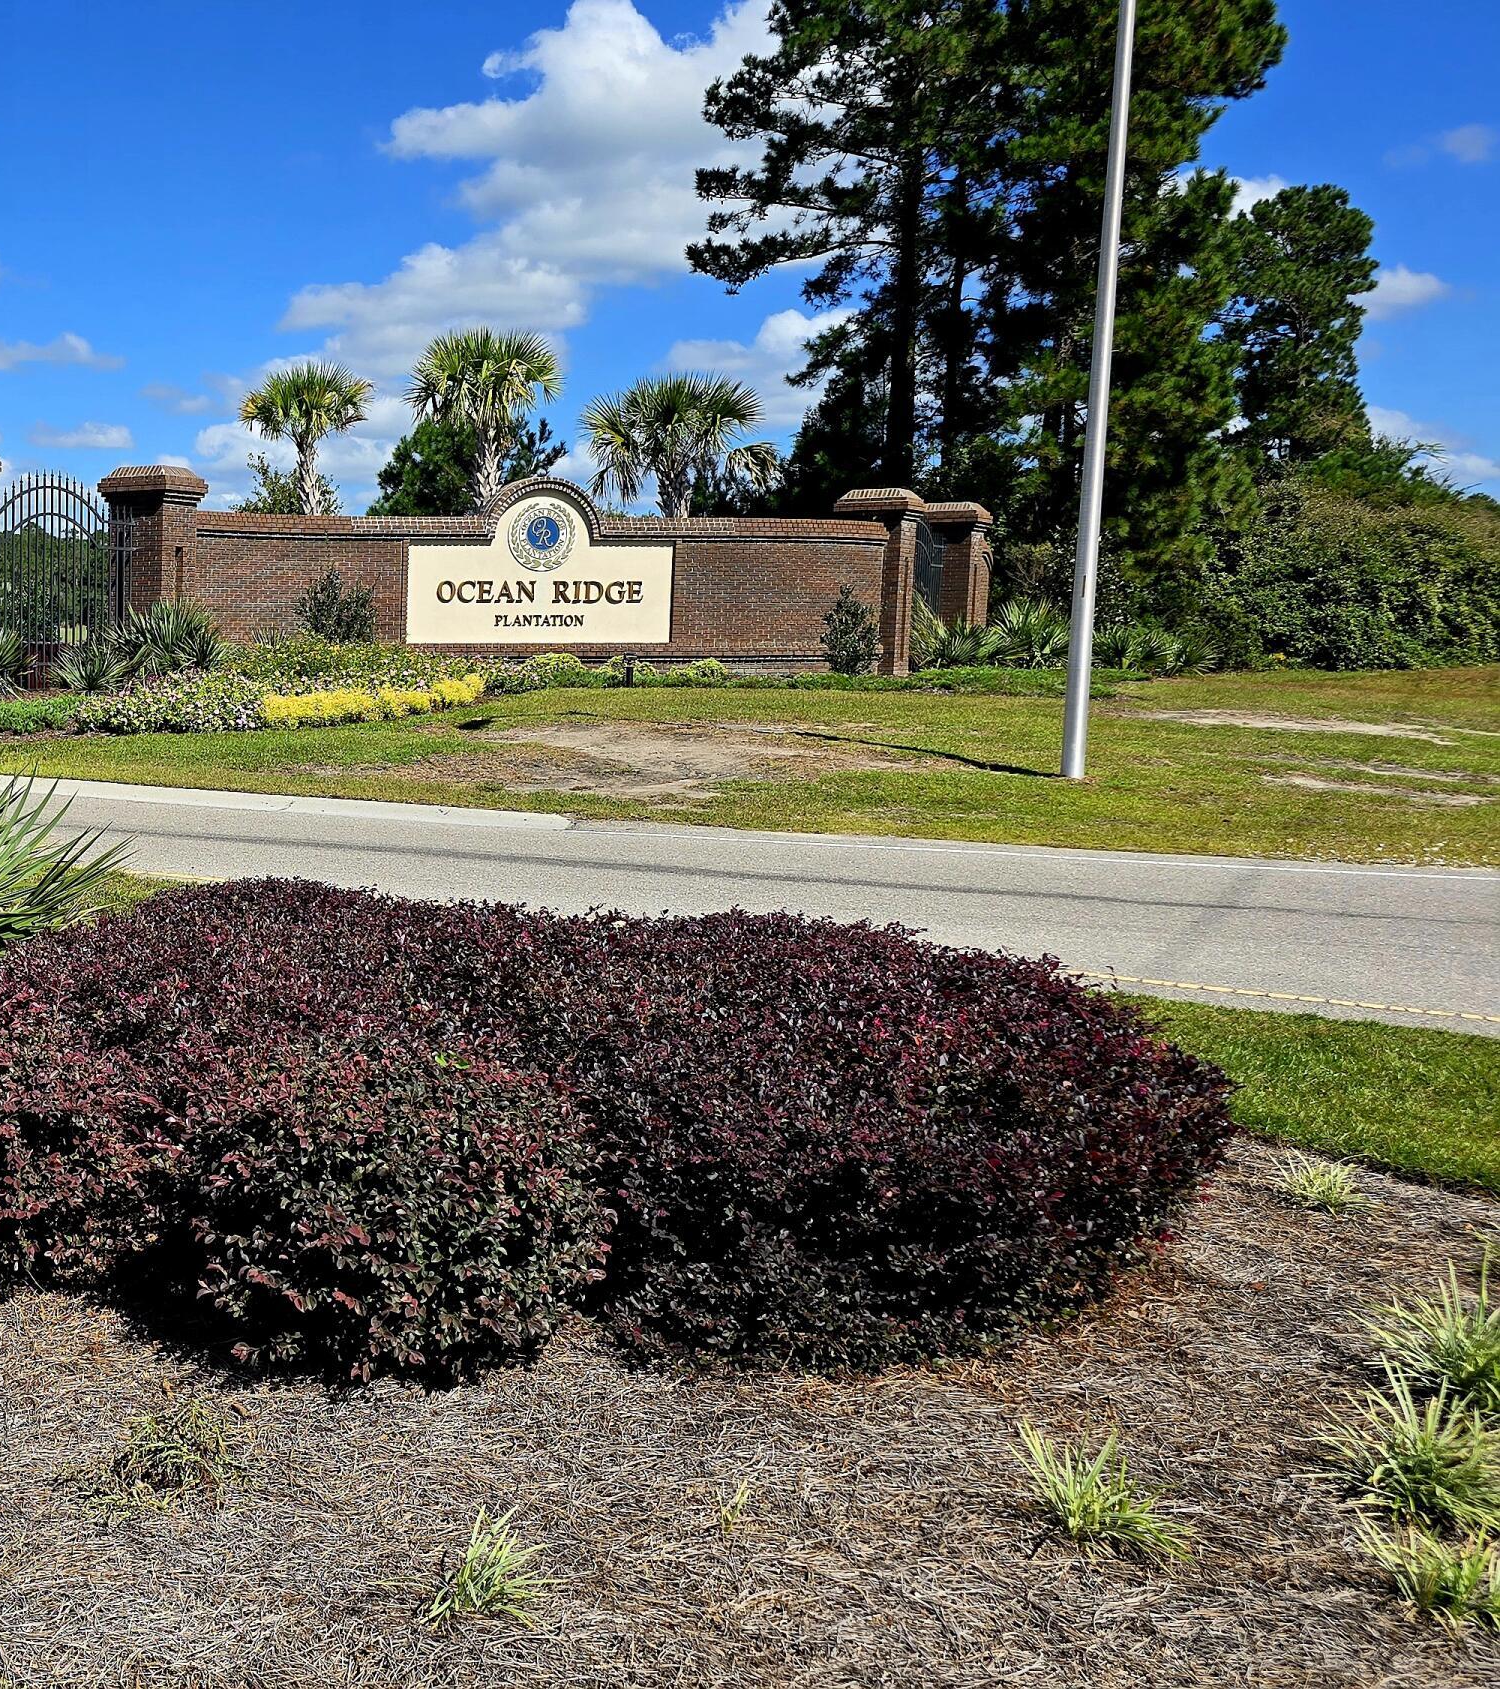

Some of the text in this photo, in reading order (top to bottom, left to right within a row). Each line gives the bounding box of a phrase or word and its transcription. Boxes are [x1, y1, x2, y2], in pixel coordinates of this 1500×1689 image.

[436, 580, 644, 604] OCEAN RIDGE
[494, 614, 585, 627] PLANTATION
